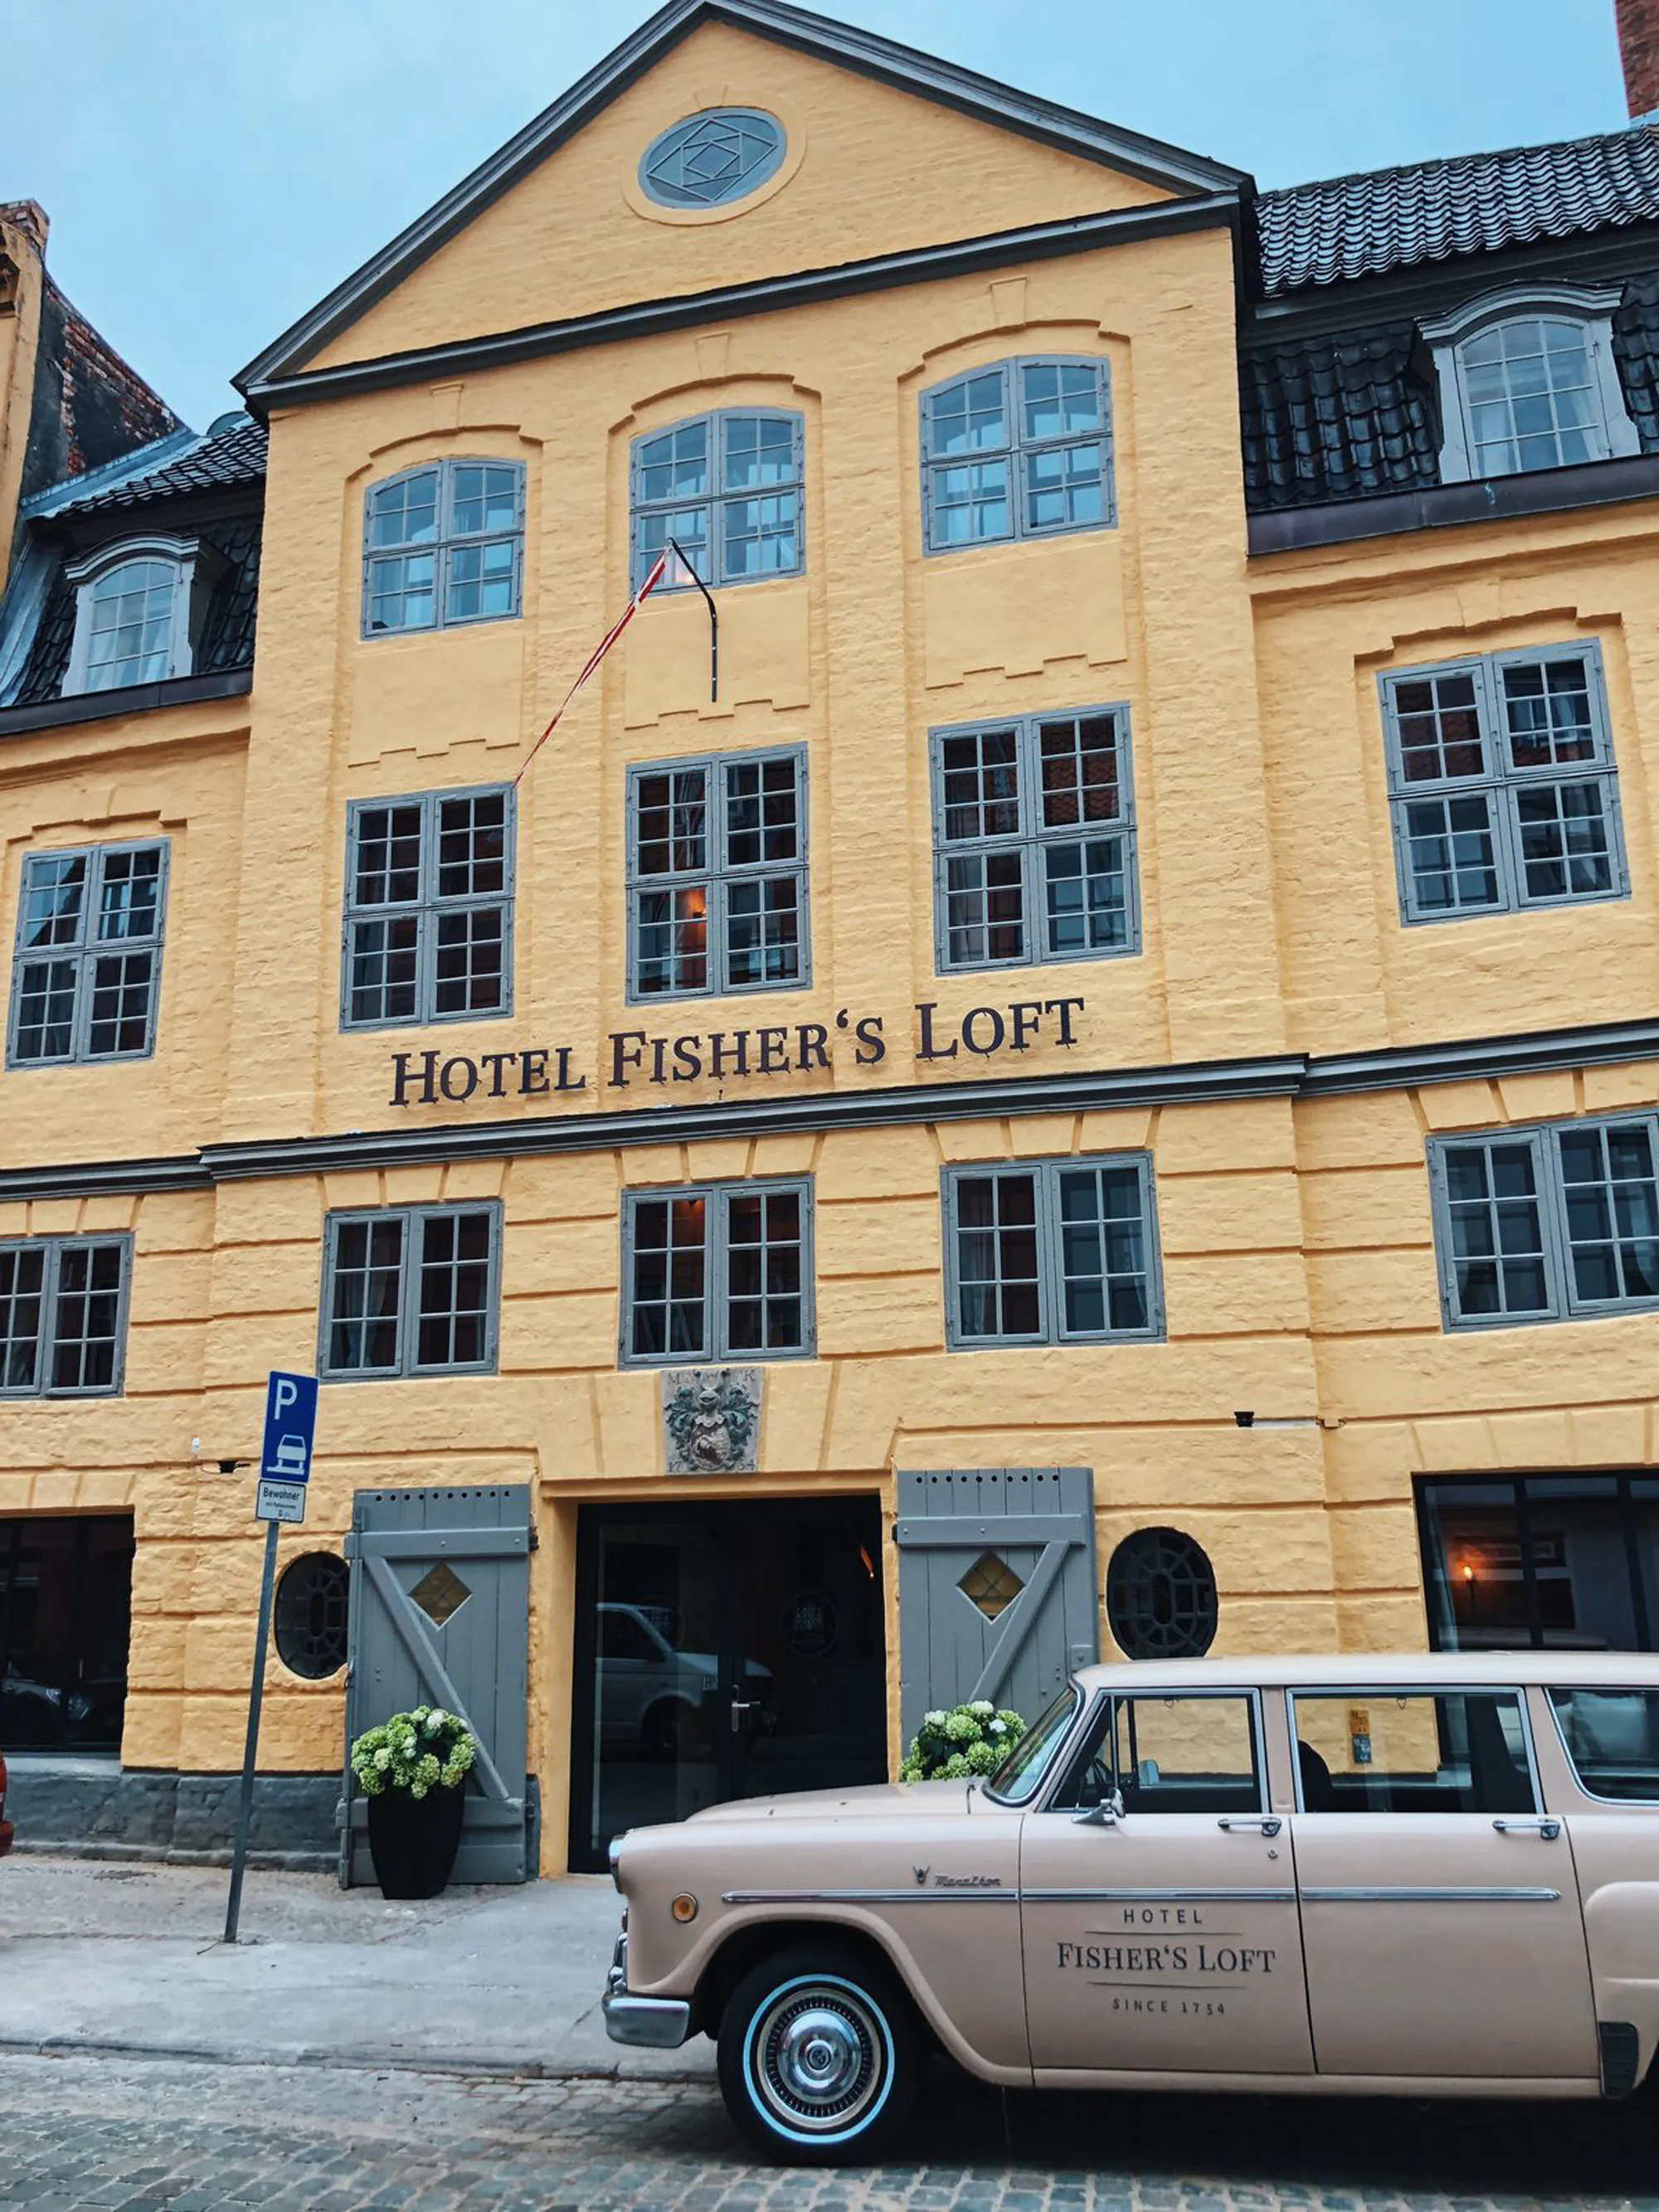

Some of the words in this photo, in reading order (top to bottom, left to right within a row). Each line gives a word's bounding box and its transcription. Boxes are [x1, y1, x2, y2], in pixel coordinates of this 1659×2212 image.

[389, 1047, 586, 1107] HOTEL
[914, 997, 1085, 1061] LOFT
[274, 1378, 298, 1421] P
[263, 1486, 299, 1500] Bewohner
[1123, 1908, 1202, 1924] HOTEL
[1198, 1944, 1277, 1973] LOFT
[1112, 1998, 1168, 2012] SINCE
[1180, 2001, 1226, 2016] 1754
